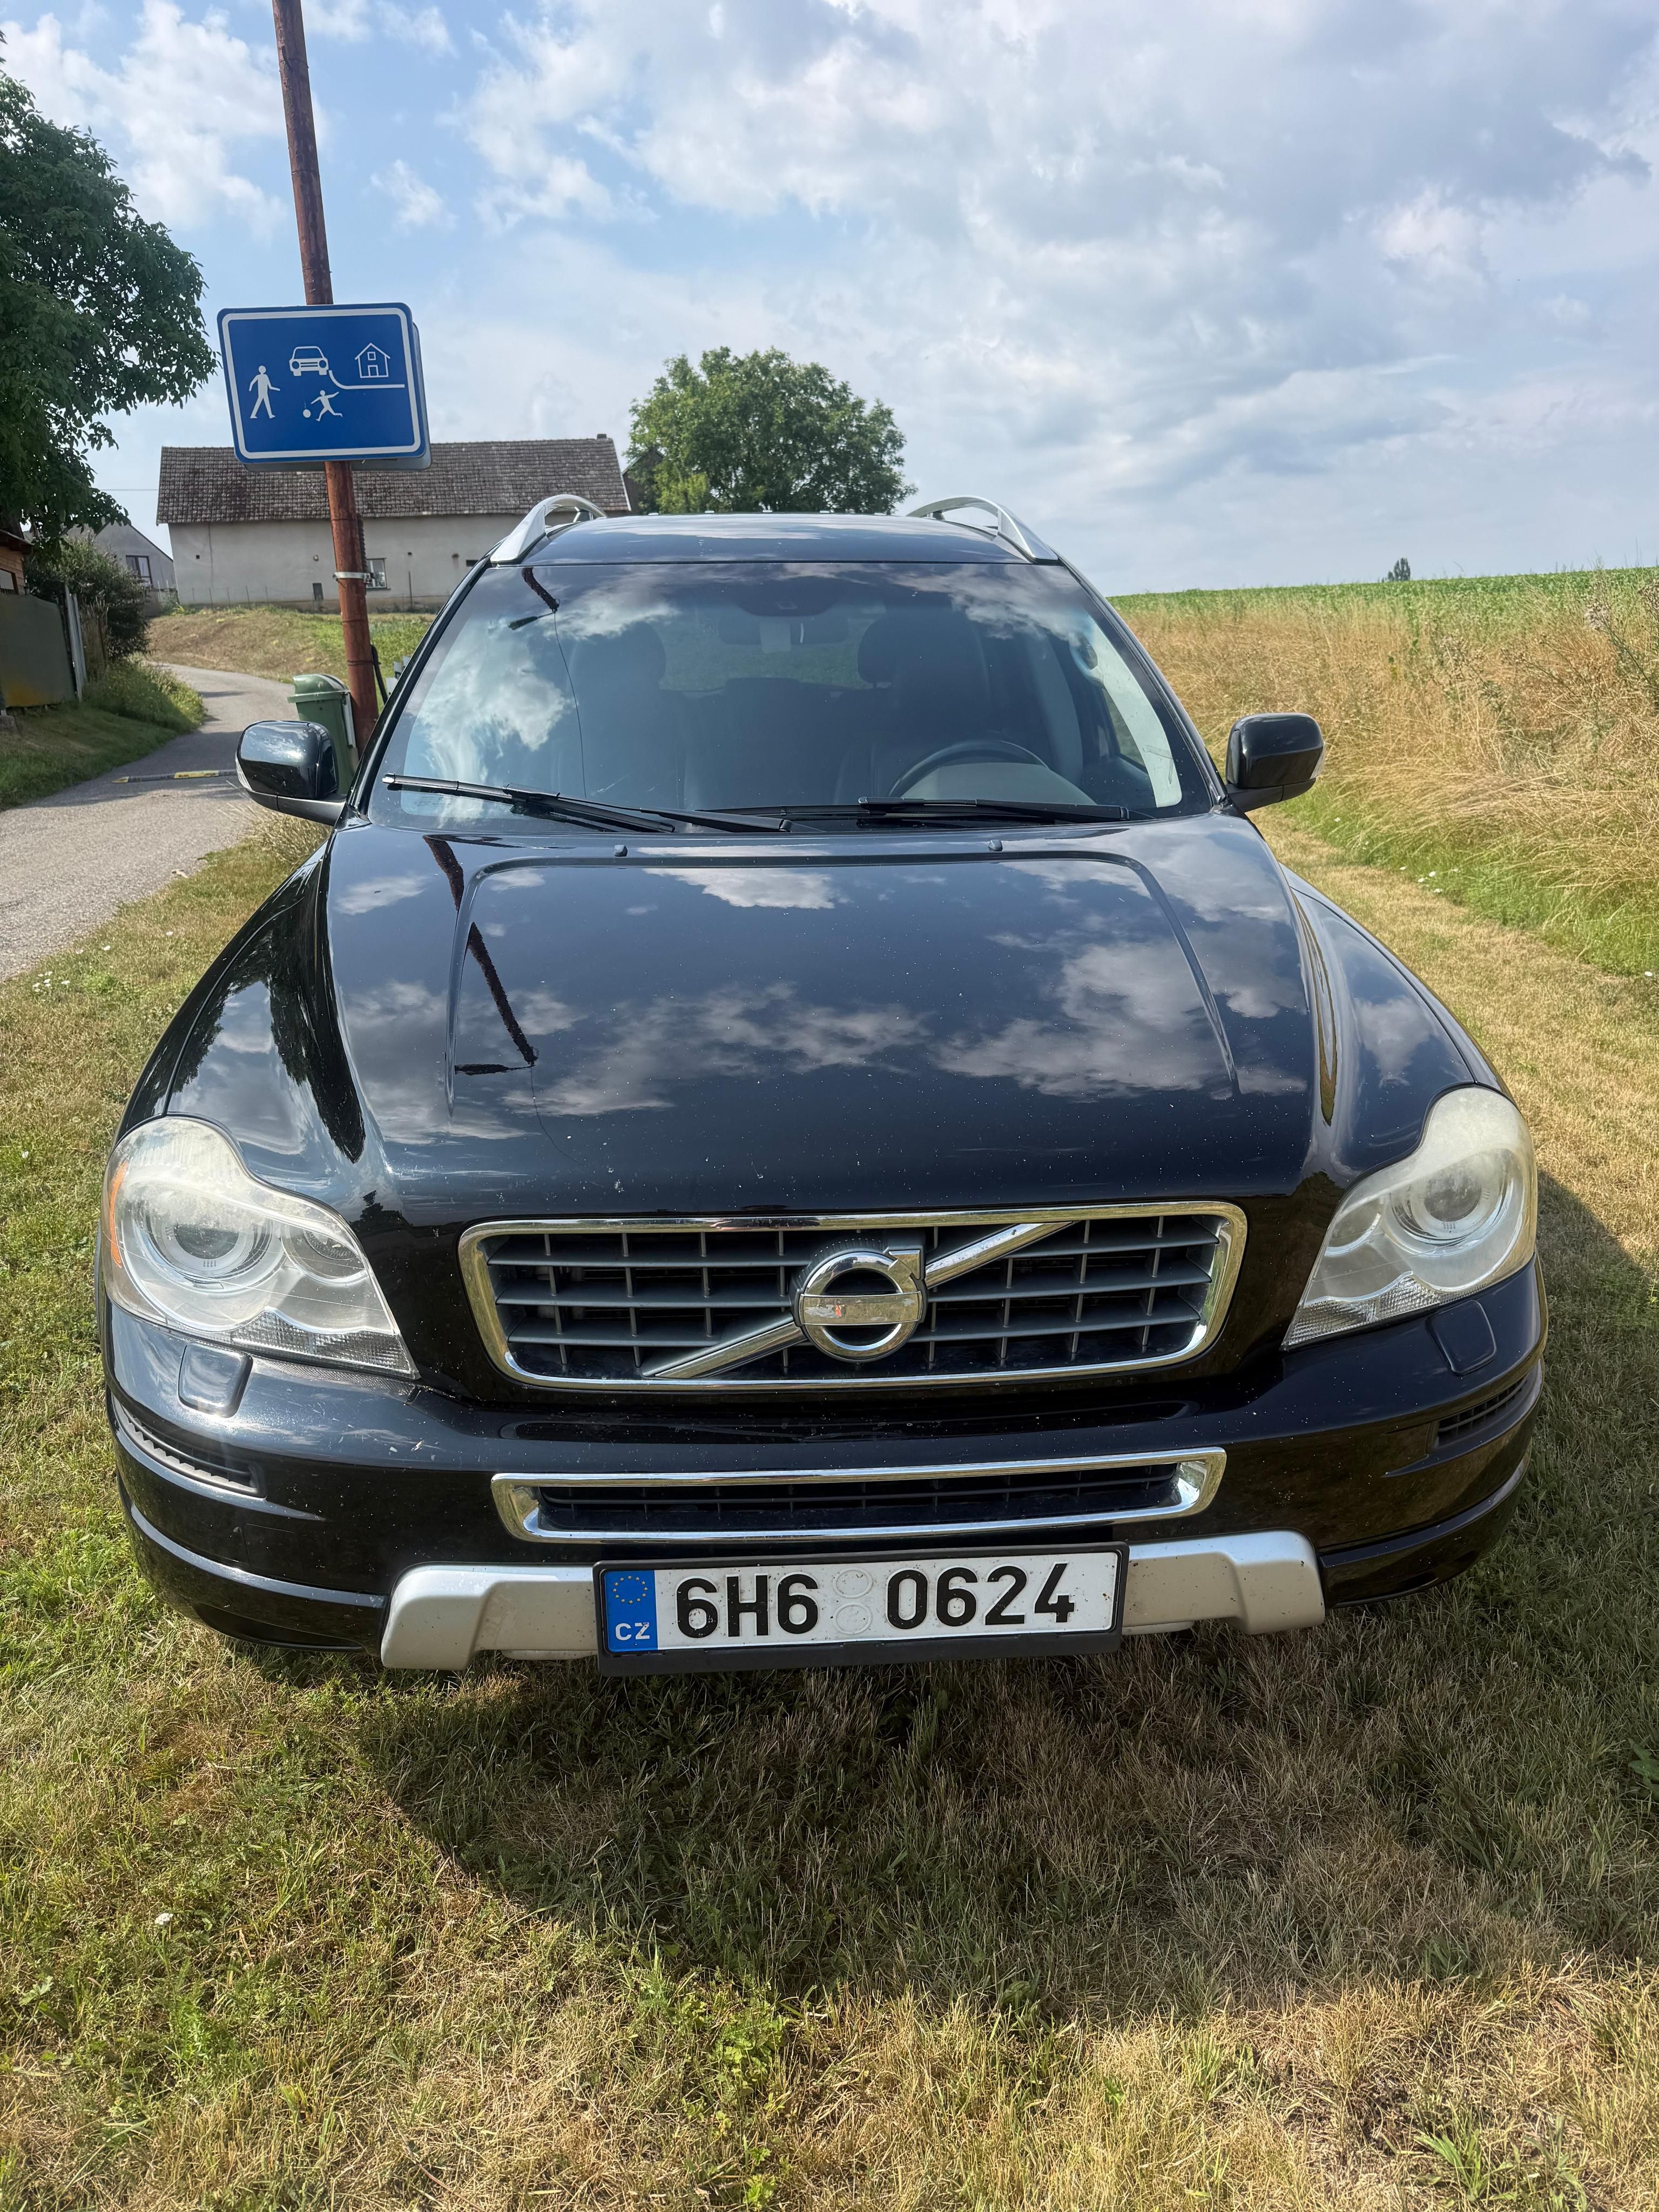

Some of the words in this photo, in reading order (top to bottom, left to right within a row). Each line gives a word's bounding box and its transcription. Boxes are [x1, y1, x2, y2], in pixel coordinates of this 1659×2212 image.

[676, 1574, 818, 1638] 6H6
[887, 1563, 1075, 1629] 0624
[615, 1622, 650, 1641] CZ
